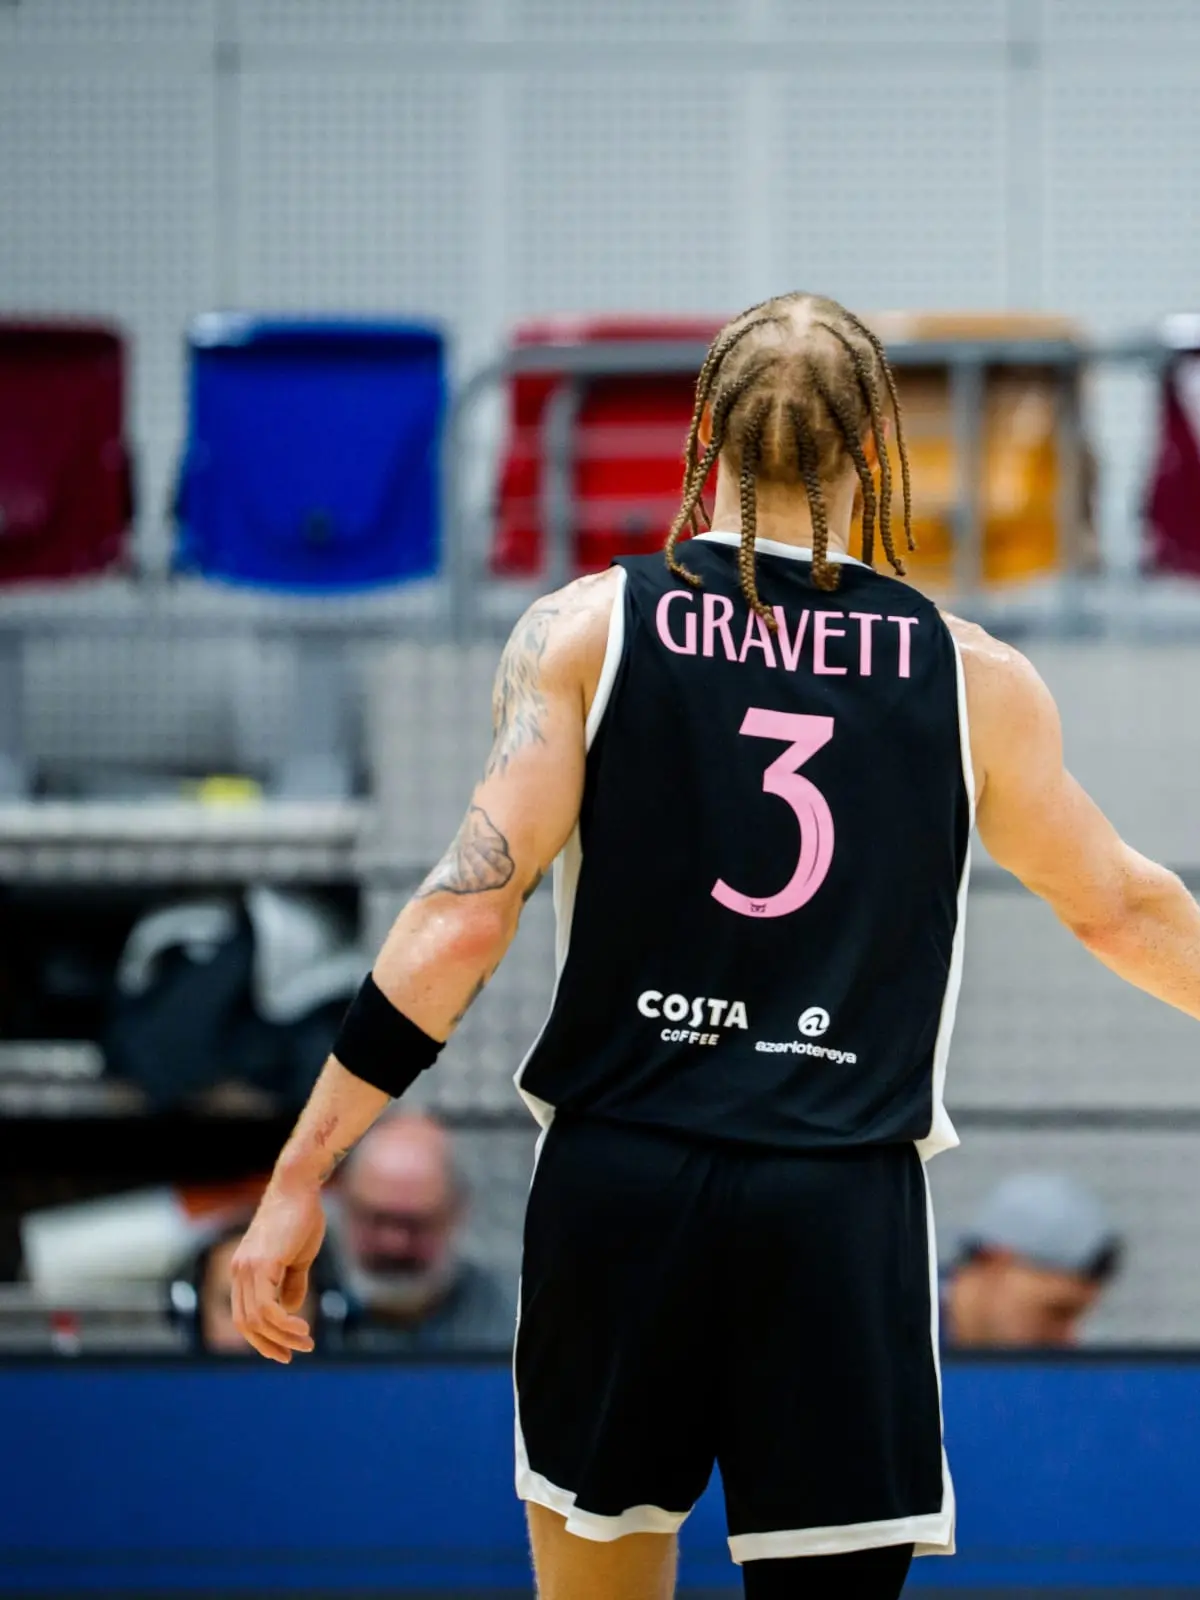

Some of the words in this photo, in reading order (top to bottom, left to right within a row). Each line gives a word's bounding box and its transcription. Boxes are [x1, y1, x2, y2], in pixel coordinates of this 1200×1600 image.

[655, 589, 919, 679] GRAVETT
[710, 706, 835, 918] 3
[637, 989, 749, 1030] COSTA
[660, 1028, 720, 1046] COFFEE
